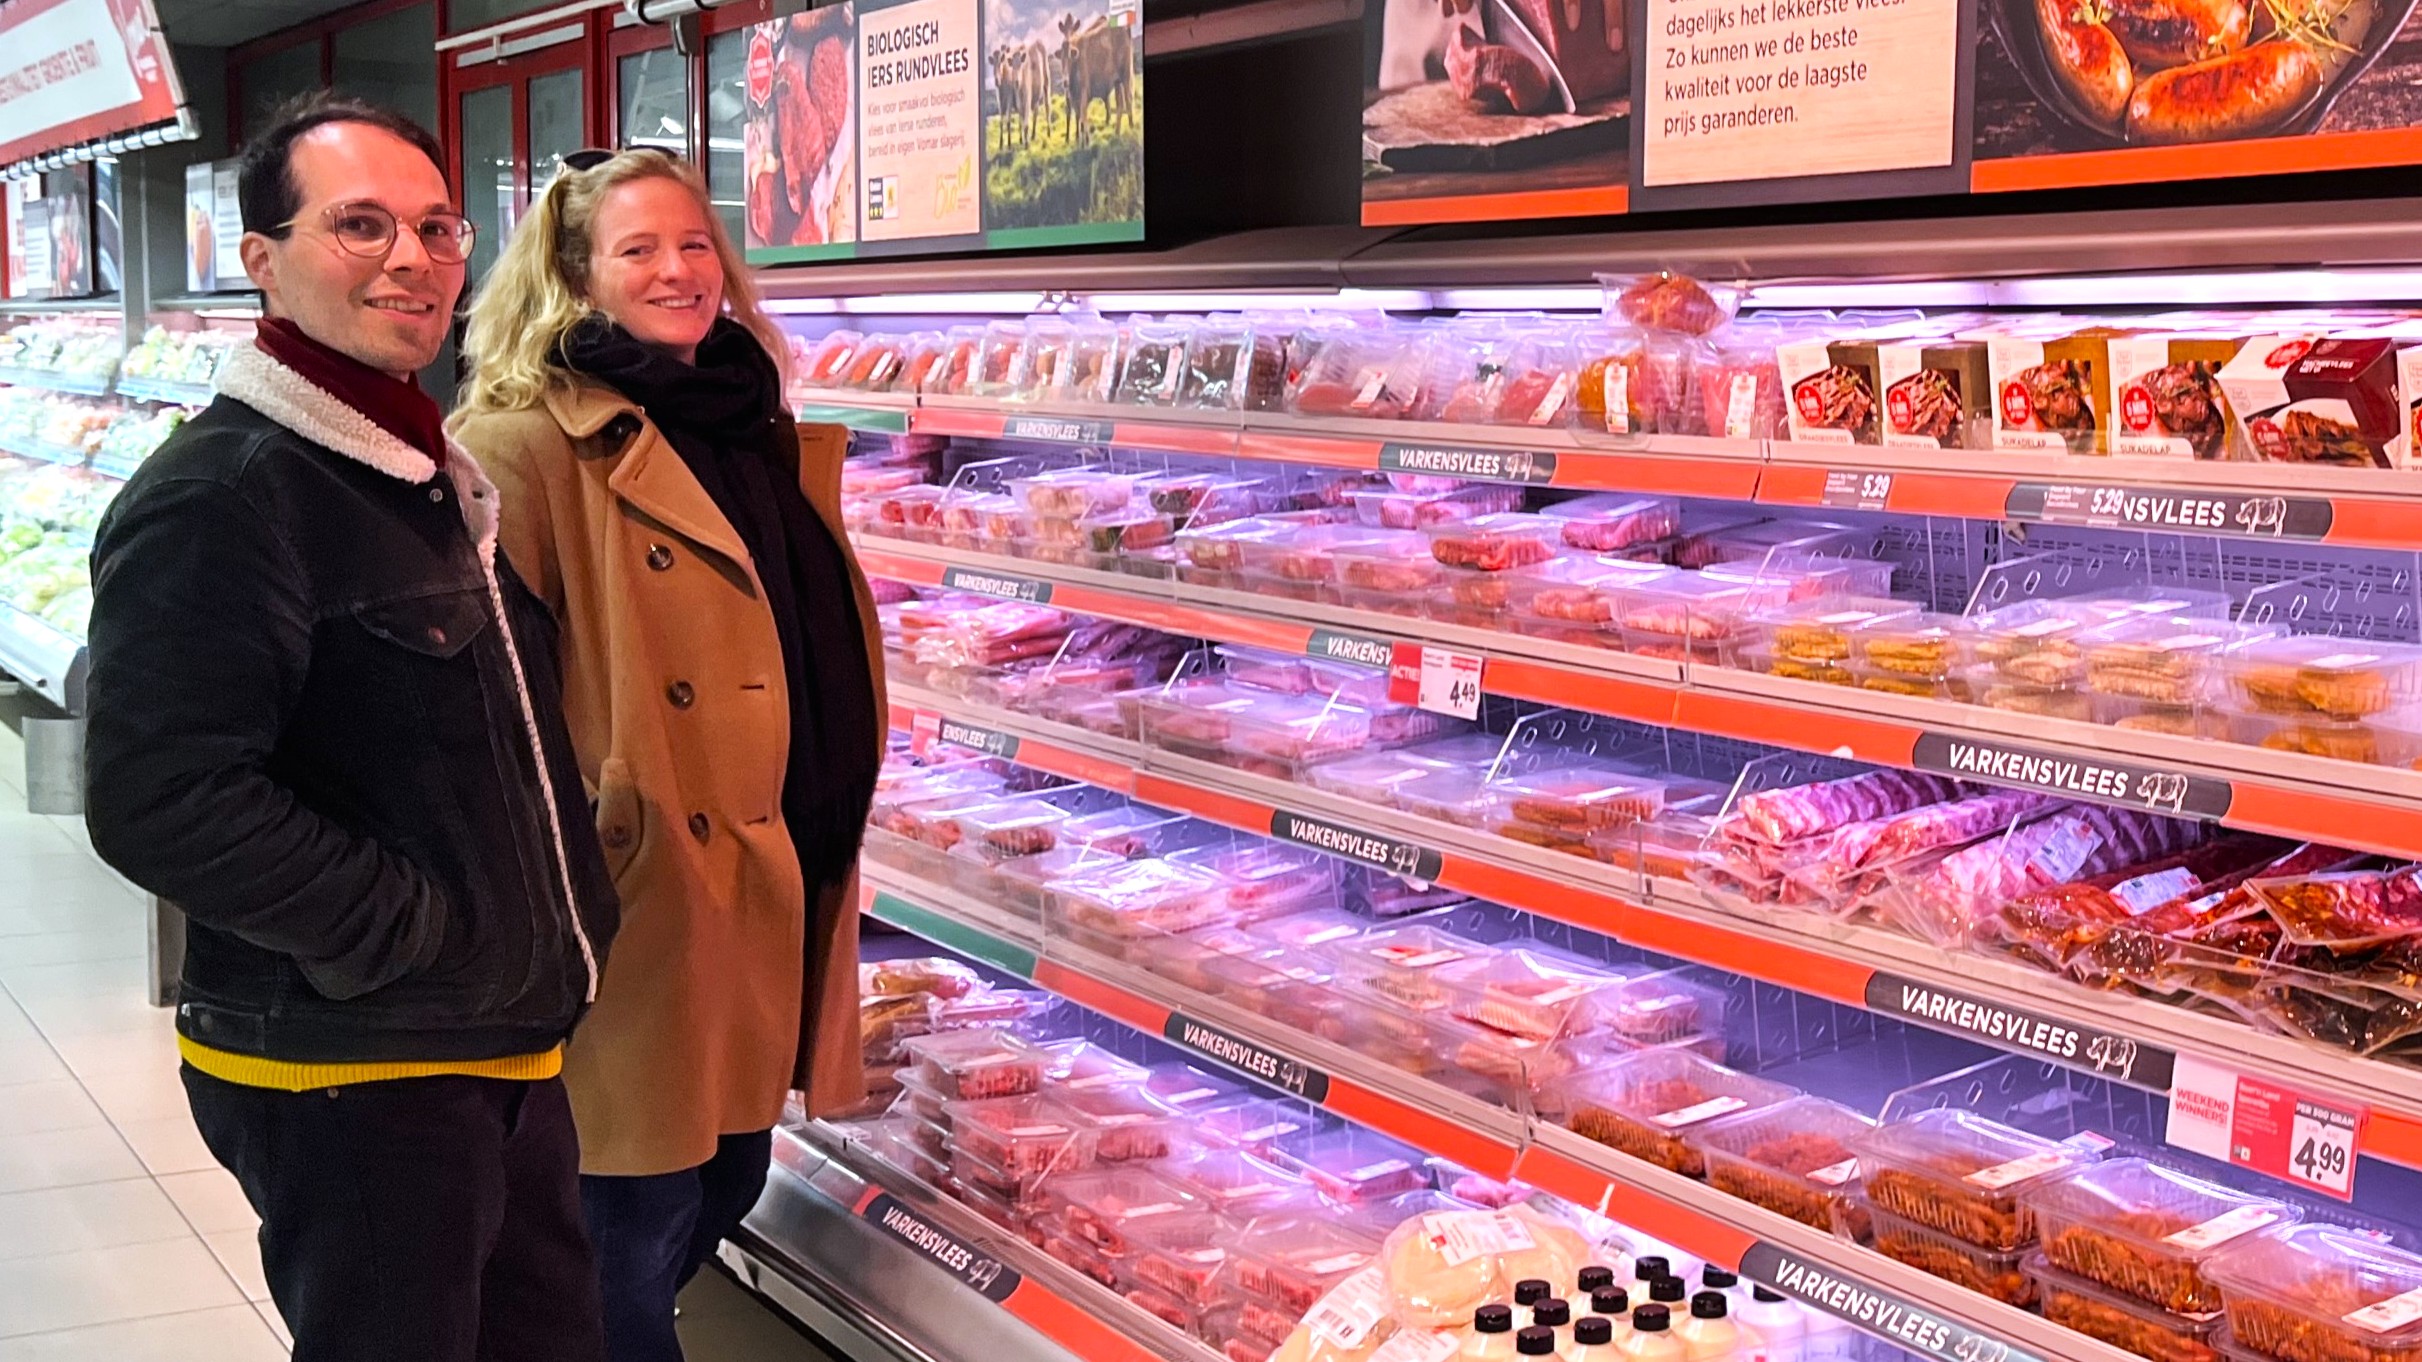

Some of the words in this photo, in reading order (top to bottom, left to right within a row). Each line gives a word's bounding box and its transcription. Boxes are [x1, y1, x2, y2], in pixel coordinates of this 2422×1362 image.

[1666, 8, 1735, 38] dagelijks
[1741, 4, 1767, 26] het
[1772, 0, 1848, 22] lekkerste
[868, 20, 939, 57] BIOLOGISCH
[1666, 47, 1686, 69] Zo
[1691, 43, 1748, 66] kunnen
[1755, 39, 1778, 58] we
[1783, 31, 1804, 54] de
[1811, 26, 1858, 51] beste
[868, 63, 893, 88] IERS
[896, 48, 969, 83] RUNDVLEES
[1665, 74, 1730, 101] kwaliteit
[1736, 73, 1773, 94] voor
[1778, 66, 1799, 89] de
[1805, 60, 1867, 88] laagste
[1664, 111, 1696, 138] prijs
[1702, 104, 1798, 135] garanderen.
[1016, 421, 1080, 440] VARKENSVLEES
[2002, 436, 2047, 448] SUKADELAP
[2120, 443, 2171, 455] SUKADELAP
[1400, 449, 1500, 475] VARKENSVLEES
[954, 572, 1019, 597] VARKENSVLEES
[1450, 681, 1476, 708] 4.49
[1949, 744, 2130, 798] VARKENSVLEES
[1290, 820, 1388, 864] VARKENSVLEES
[1902, 985, 2079, 1058] VARKENSVLEES
[1184, 1023, 1278, 1078] VARKENSVLEES
[2175, 1101, 2227, 1125] WINNERS!
[2176, 1087, 2229, 1112] WEEKEND
[2296, 1102, 2312, 1115] PER
[2330, 1112, 2355, 1127] GRAM
[2295, 1137, 2345, 1181] 4.99
[882, 1207, 970, 1273] VARKENSVLEES
[1775, 1258, 1950, 1351] VARKENSVLEES
